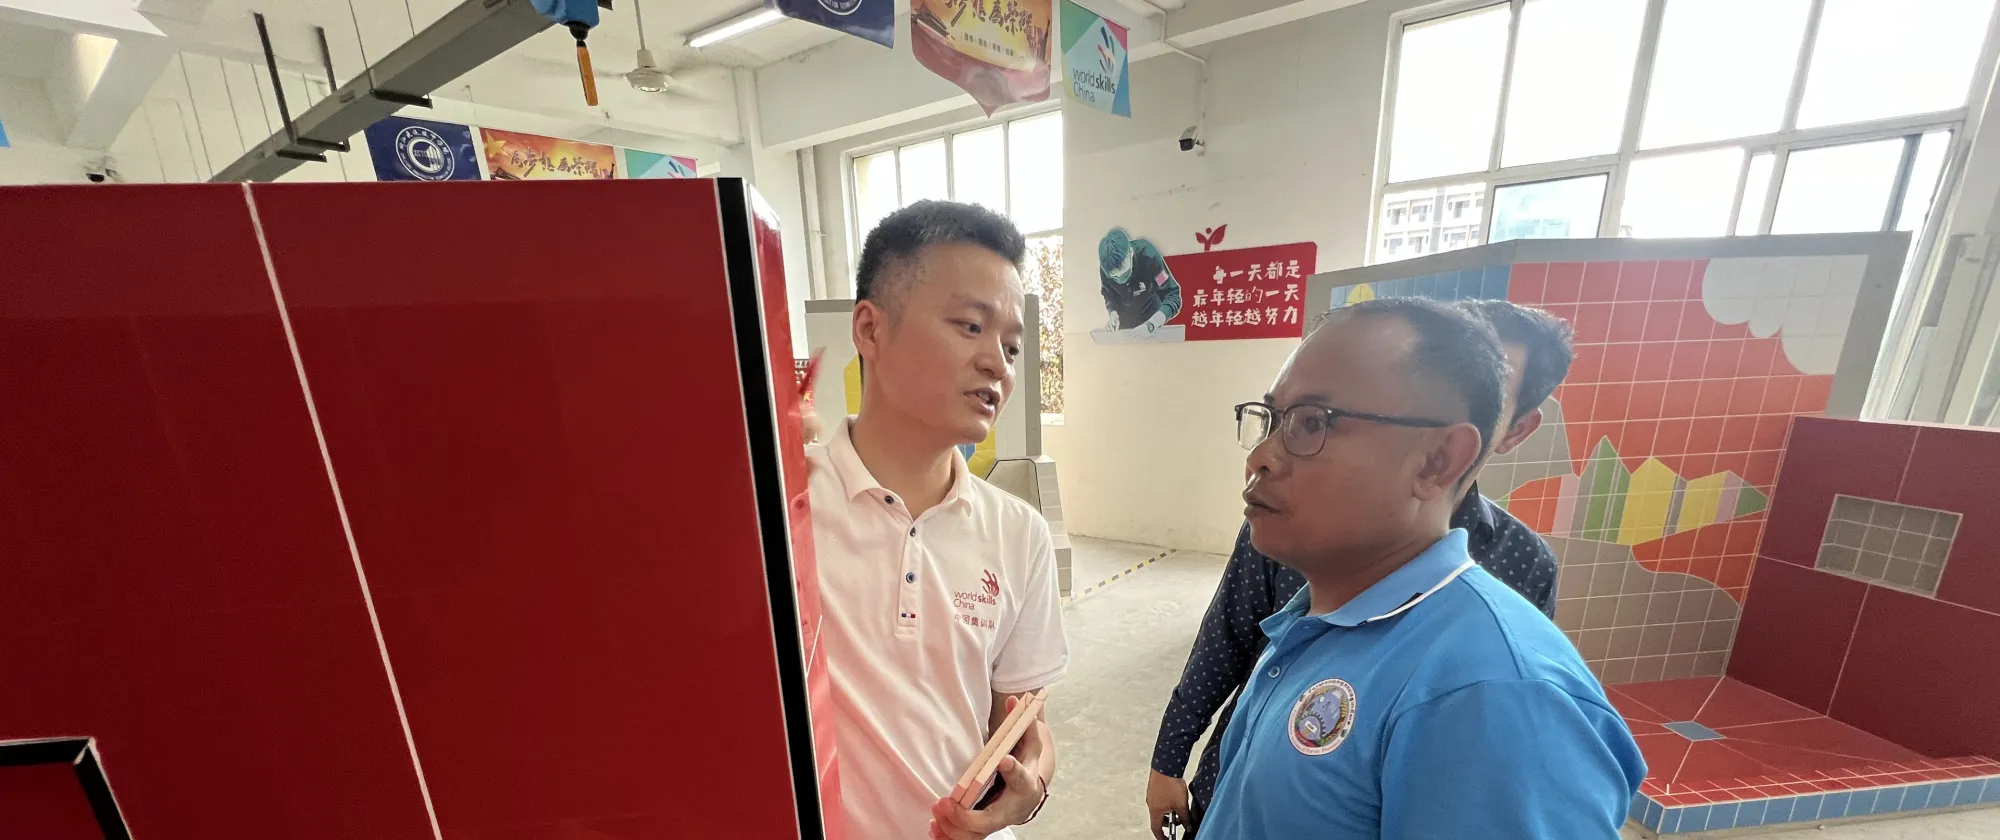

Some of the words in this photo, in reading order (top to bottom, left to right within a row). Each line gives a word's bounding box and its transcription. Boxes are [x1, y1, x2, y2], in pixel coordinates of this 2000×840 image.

[1073, 81, 1095, 102] China
[1193, 284, 1299, 307] 最年轻的一天
[1191, 306, 1298, 328] 越年轻越努力
[953, 598, 975, 611] China
